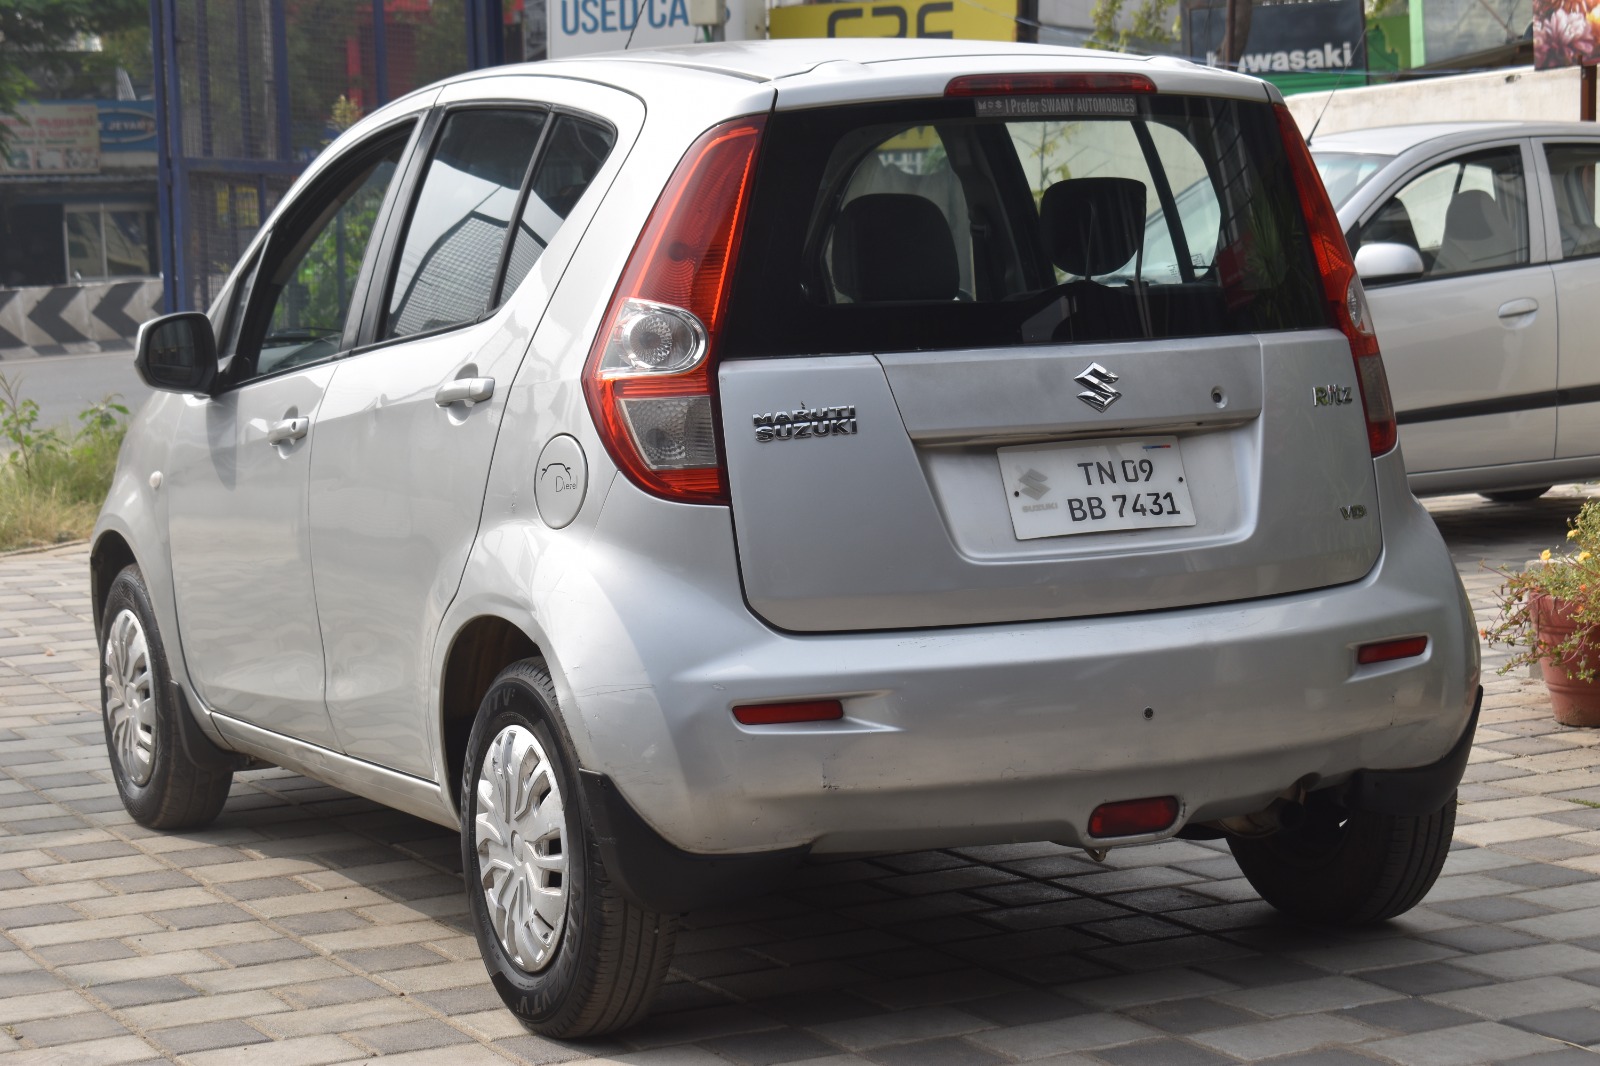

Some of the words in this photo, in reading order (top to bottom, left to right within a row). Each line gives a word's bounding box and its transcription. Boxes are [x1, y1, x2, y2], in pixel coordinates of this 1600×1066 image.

[561, 0, 638, 36] USED
[1010, 98, 1039, 113] Prefer
[1041, 97, 1074, 113] SWAMY
[1077, 97, 1135, 113] AUTOMOBILES
[1312, 384, 1353, 407] Ritz
[752, 405, 856, 427] MARUTI
[755, 418, 858, 443] SUZUKI
[1077, 460, 1117, 486] TN
[1121, 458, 1154, 483] 09
[1022, 502, 1058, 514] SUZUKI
[1067, 496, 1107, 522] BB
[1111, 491, 1181, 518] 7431
